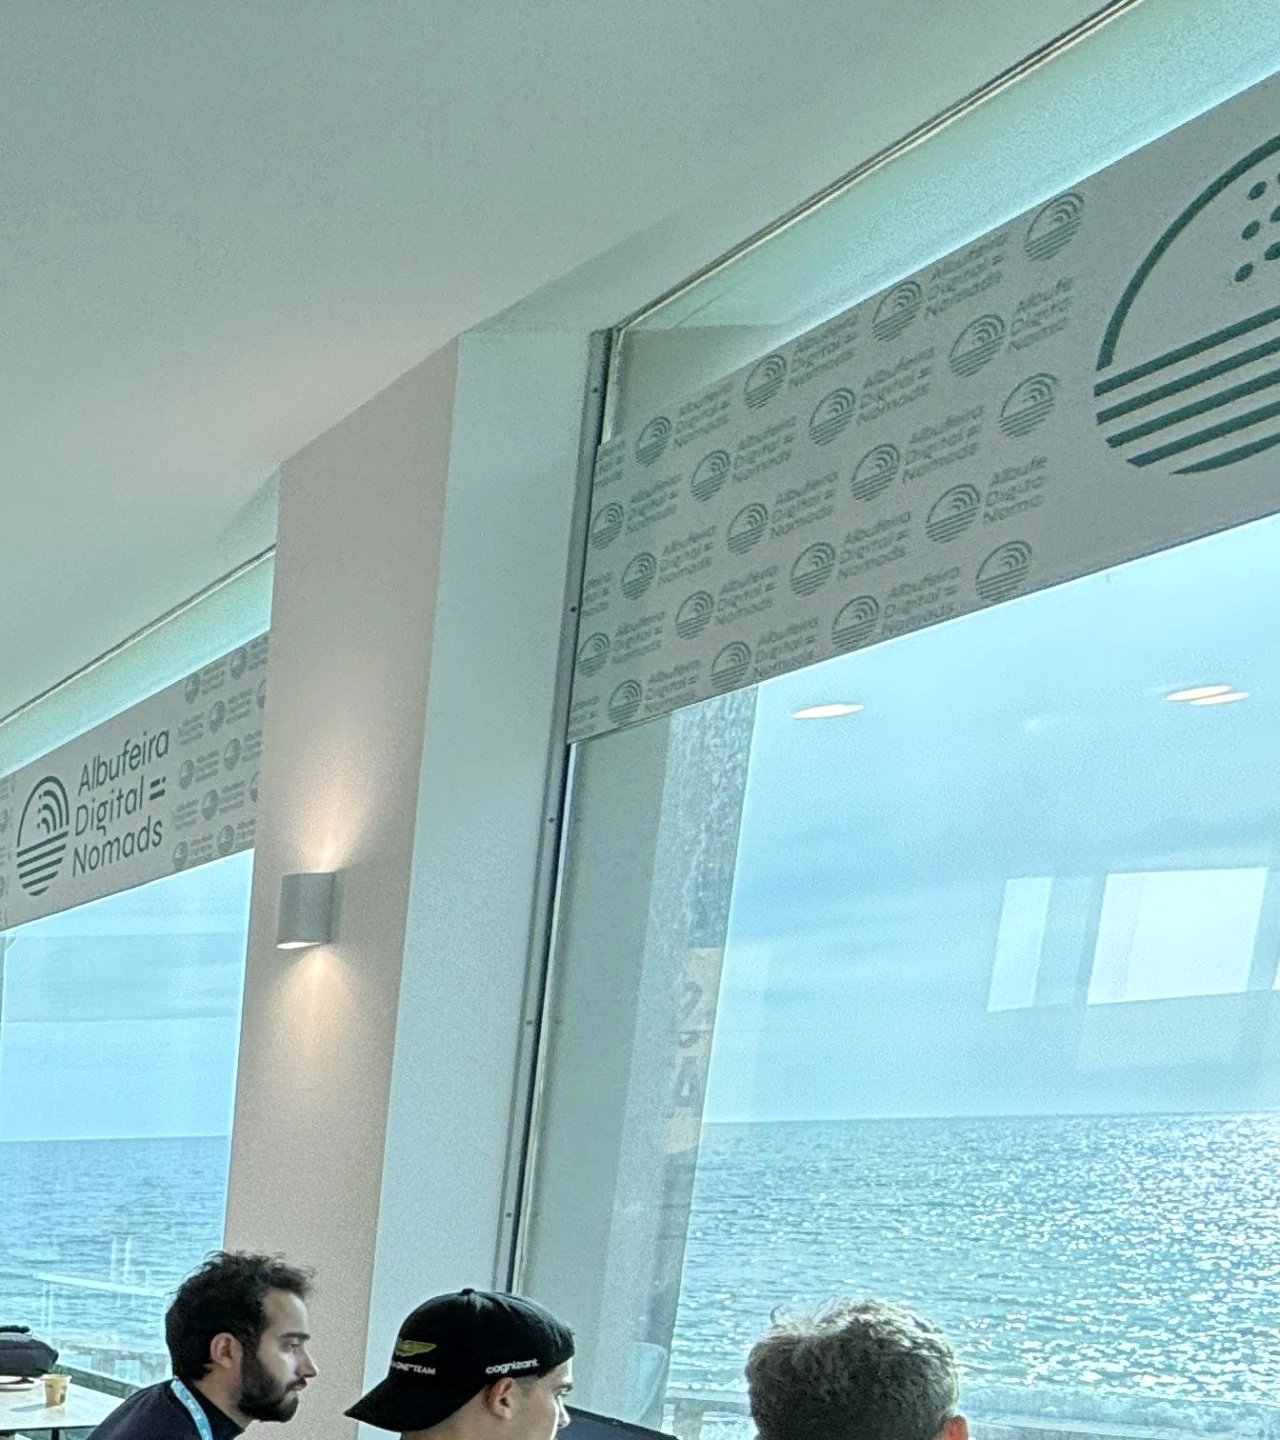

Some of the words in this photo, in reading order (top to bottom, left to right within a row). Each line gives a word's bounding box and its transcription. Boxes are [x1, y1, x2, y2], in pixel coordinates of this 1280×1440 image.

[78, 729, 170, 796] Albufeira
[75, 774, 144, 836] Digital
[72, 815, 163, 877] Nomads
[485, 1358, 540, 1375] cognizant
